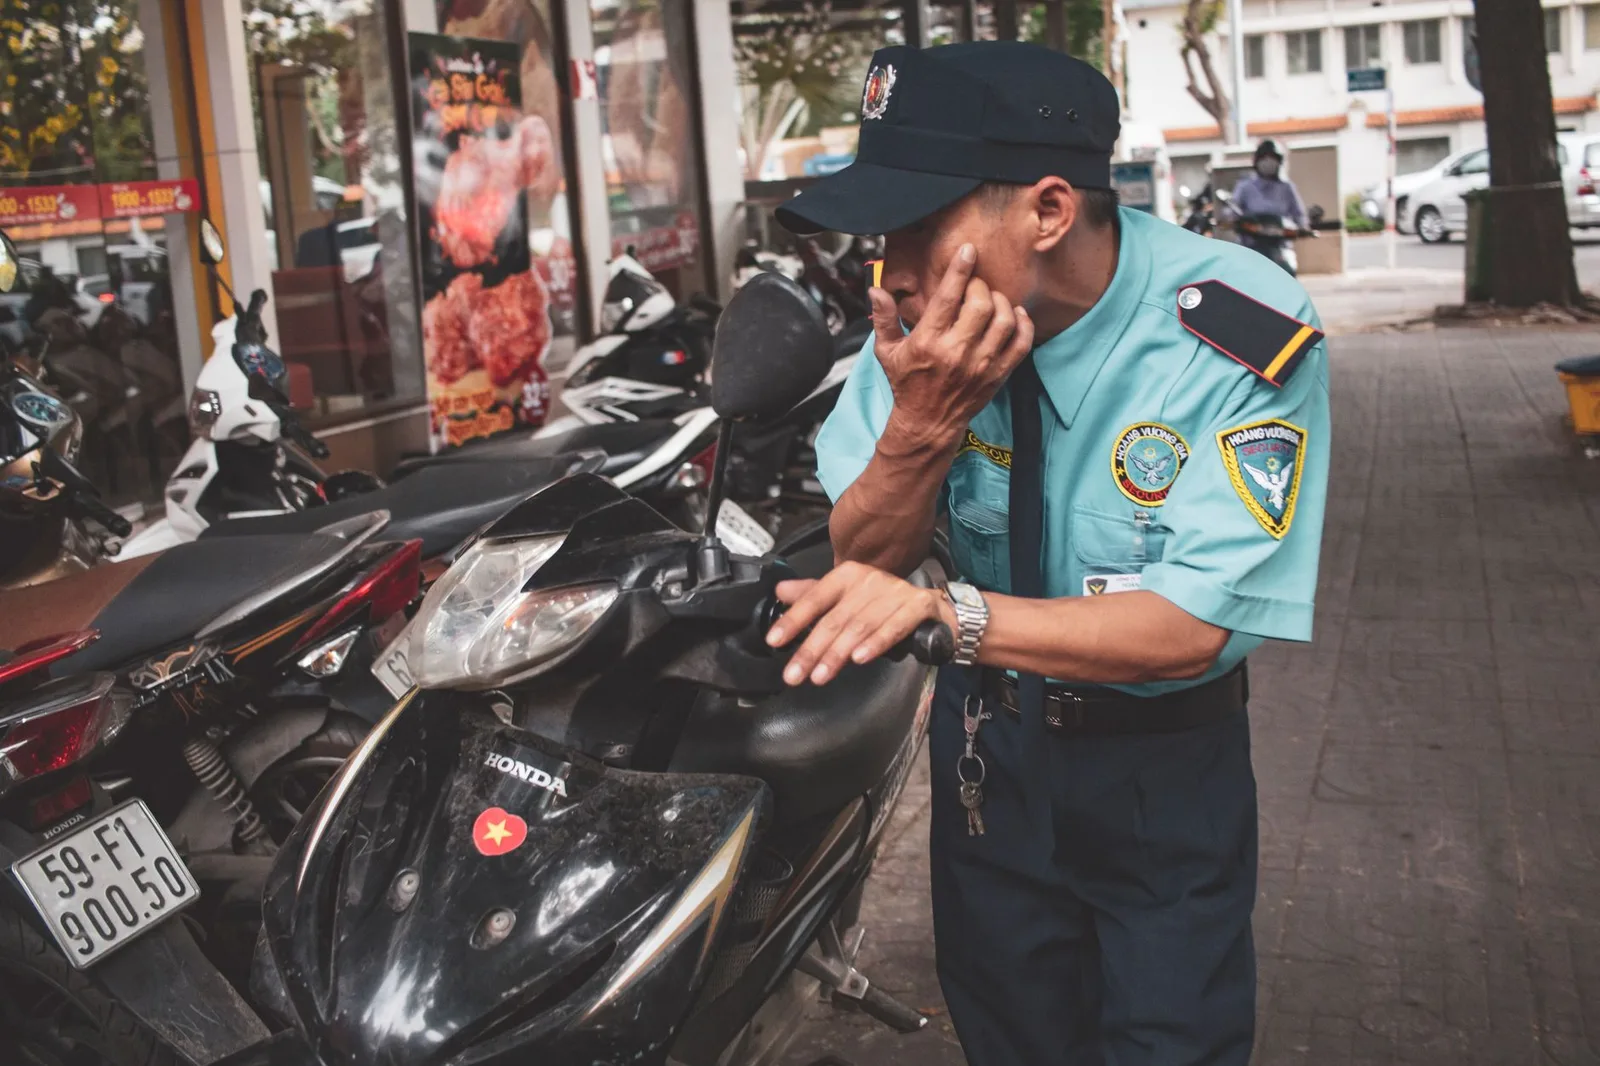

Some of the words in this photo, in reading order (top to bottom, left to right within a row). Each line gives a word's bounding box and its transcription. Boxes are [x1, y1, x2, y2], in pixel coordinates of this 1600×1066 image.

[484, 752, 567, 798] HONDA
[38, 816, 145, 899] 59-F1
[43, 813, 86, 840] HONDA
[60, 856, 186, 956] 900.50
